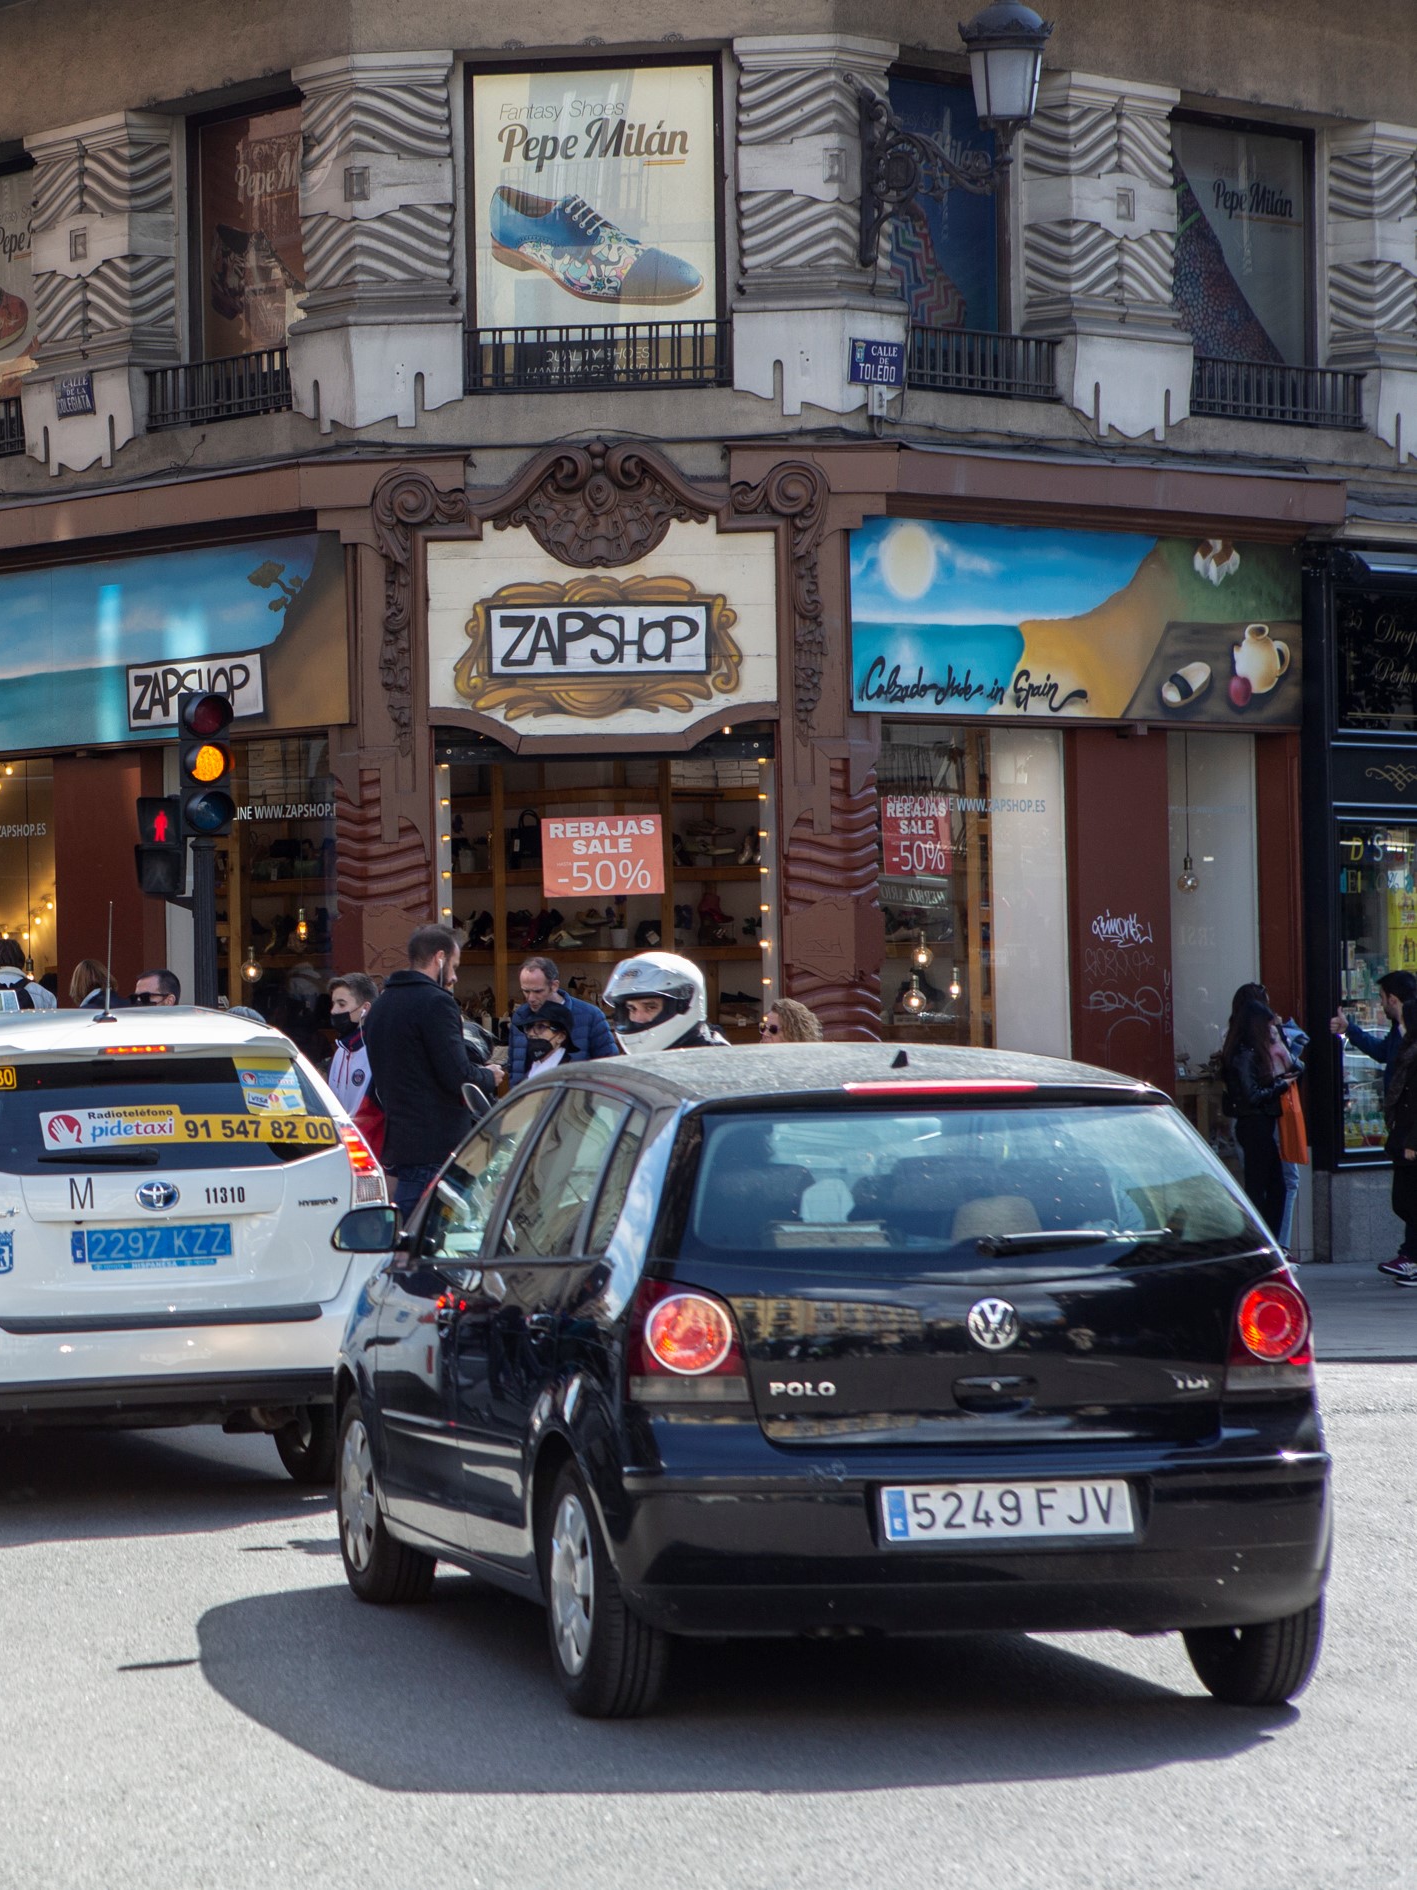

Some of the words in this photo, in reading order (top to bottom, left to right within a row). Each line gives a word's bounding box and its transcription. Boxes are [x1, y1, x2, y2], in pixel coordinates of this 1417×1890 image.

[499, 101, 563, 122] Fantasy
[569, 100, 624, 118] Shoes
[498, 124, 578, 173] Pepe
[583, 117, 689, 158] Milán
[1213, 178, 1247, 219] Pepe
[1249, 182, 1293, 218] Milán
[871, 345, 898, 357] CALLE
[879, 357, 889, 365] DE
[62, 376, 89, 388] CALLE
[859, 363, 896, 382] TOLEDO
[499, 611, 700, 667] ZAPSHOP
[1374, 613, 1417, 655] Drog
[987, 678, 1004, 705] in
[1014, 669, 1081, 712] Spain
[886, 802, 947, 818] REBAJAS
[956, 797, 1046, 813] WWW.ZAPSHOP.ES
[549, 819, 655, 838] REBAJAS
[900, 819, 935, 835] SALE
[572, 838, 633, 855] SALE
[892, 840, 945, 871] -50%
[558, 859, 651, 891] -50%
[251, 1094, 268, 1104] VISA
[88, 1108, 174, 1119] Radioteléfono
[91, 1118, 174, 1143] pidetaxi
[185, 1119, 211, 1139] 91
[221, 1120, 261, 1139] 547
[270, 1120, 299, 1139] 82
[305, 1121, 332, 1140] 00
[69, 1177, 94, 1210] M
[205, 1187, 245, 1204] 11310
[76, 1250, 83, 1258] E
[91, 1230, 161, 1259] 2297
[173, 1228, 225, 1255] KZZ
[769, 1381, 836, 1397] POLO
[909, 1488, 1023, 1531] 5249
[1034, 1486, 1114, 1526] FJV
